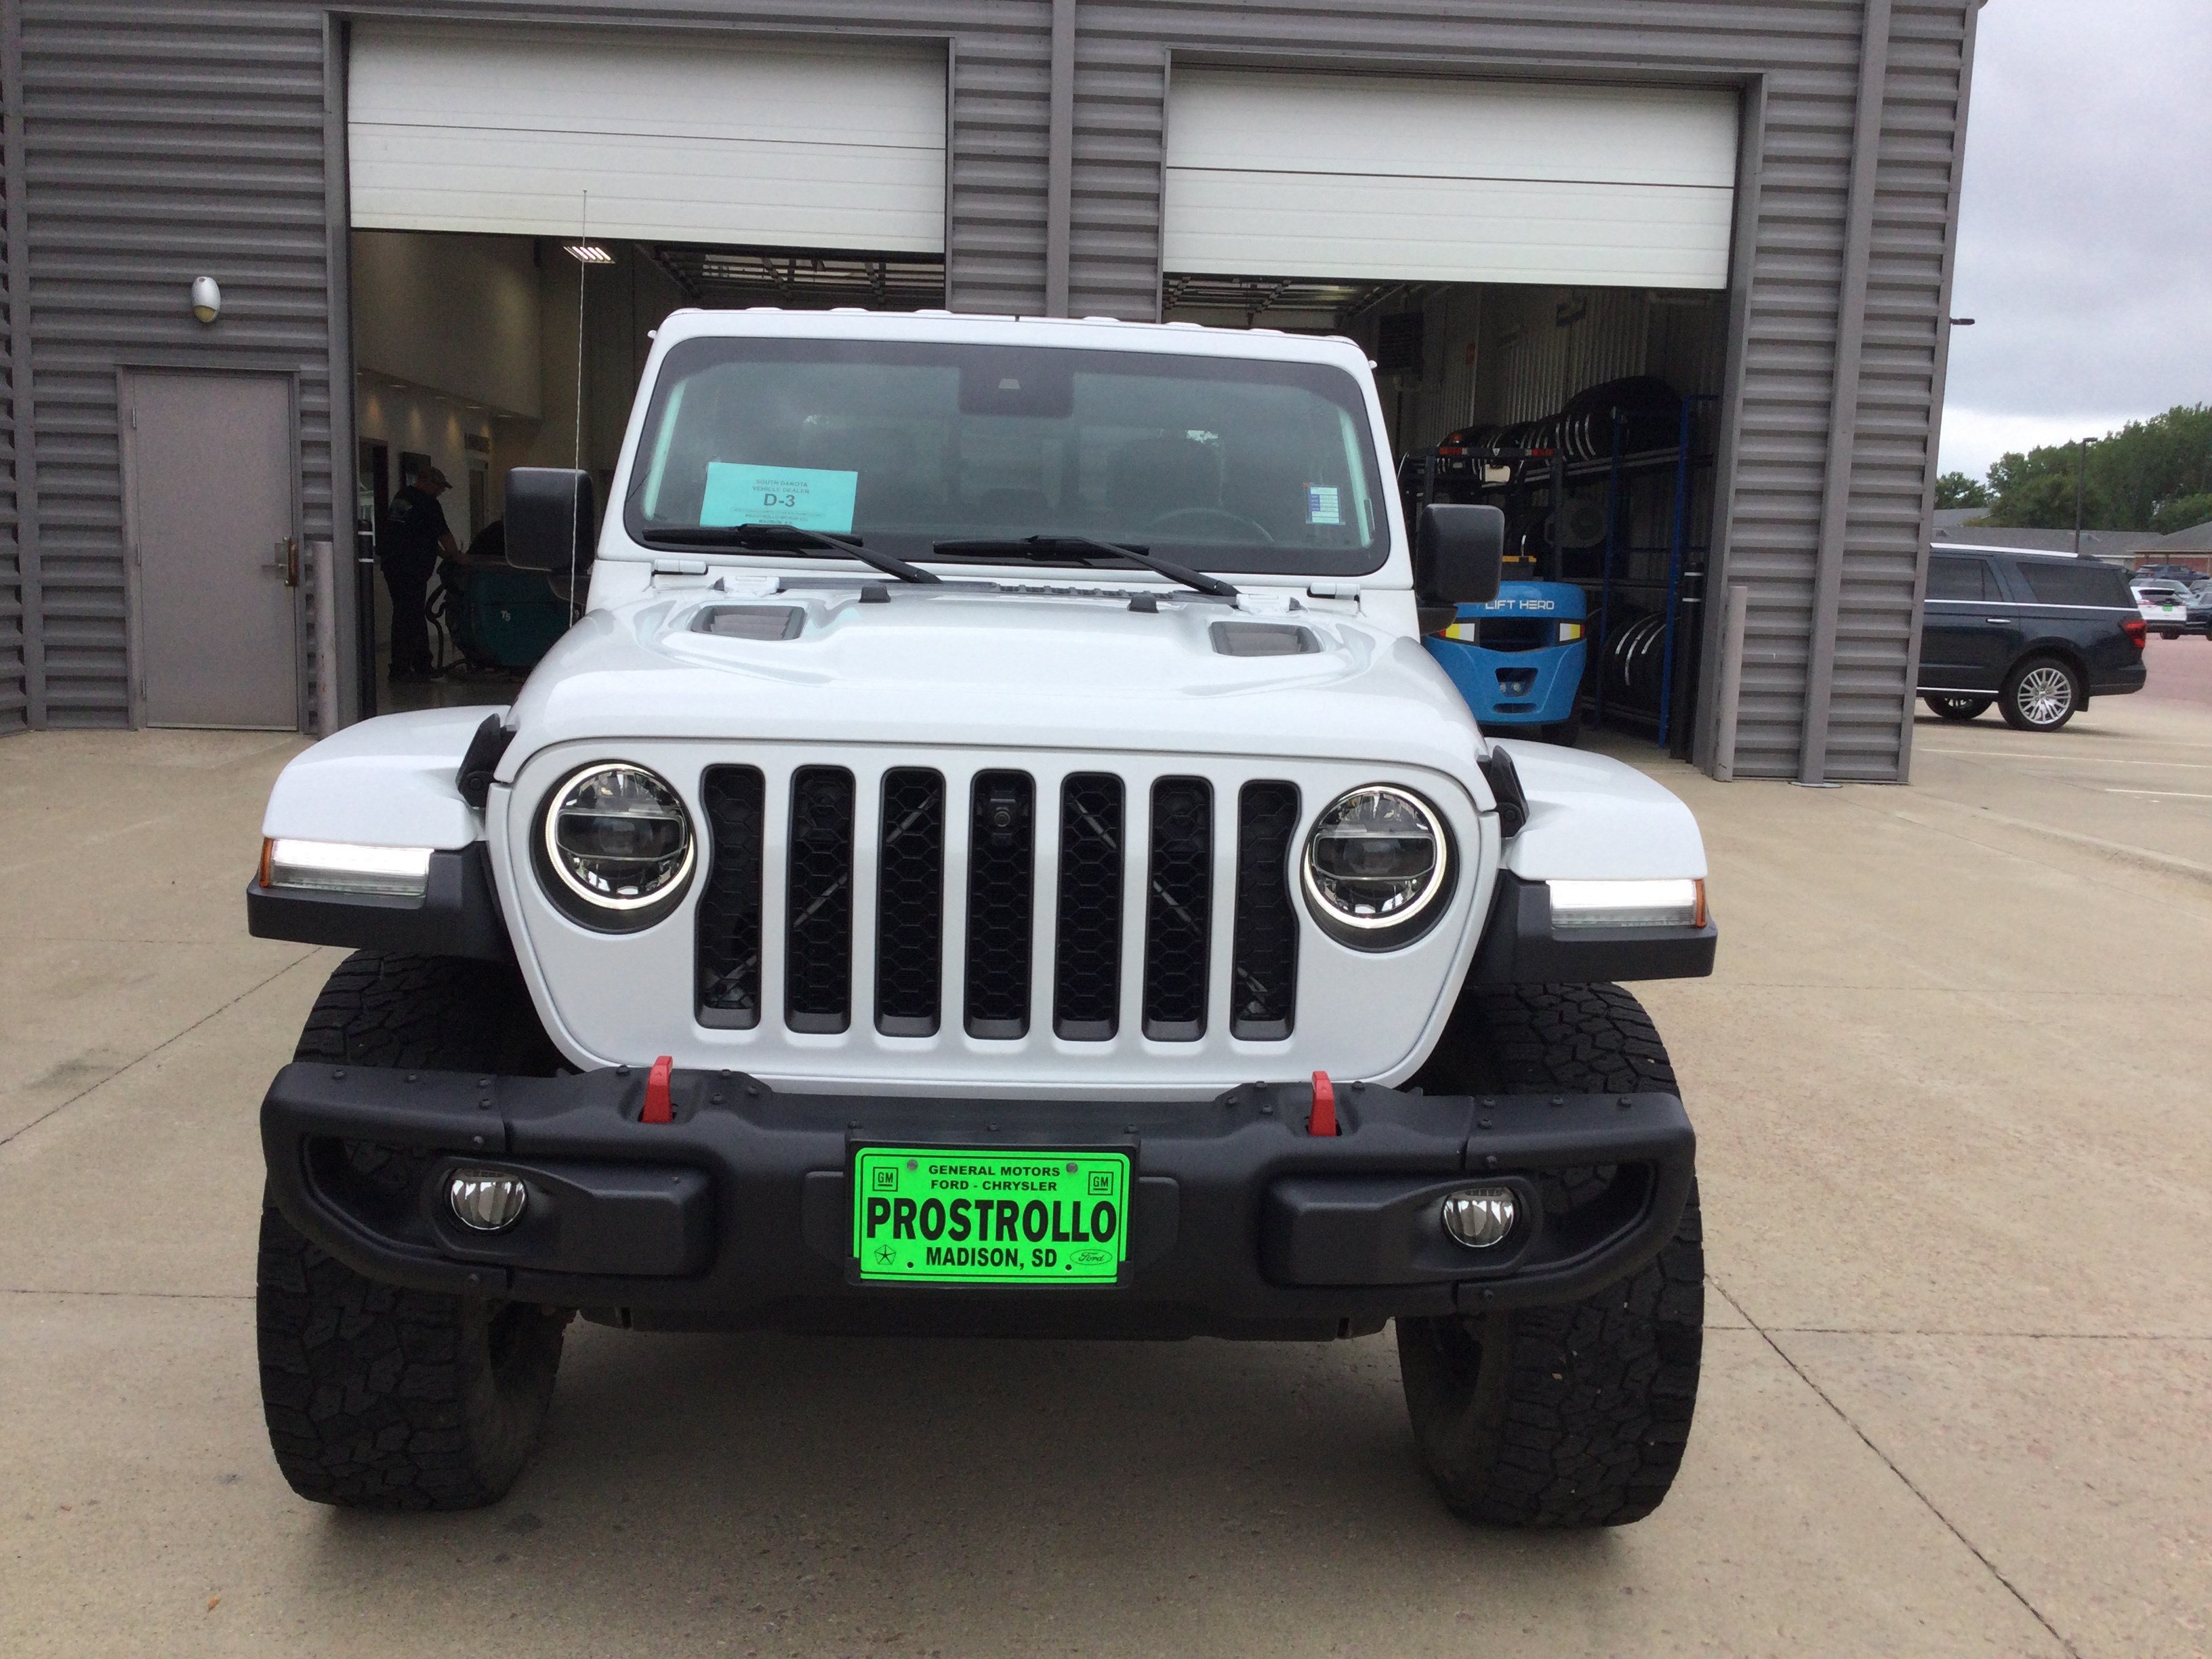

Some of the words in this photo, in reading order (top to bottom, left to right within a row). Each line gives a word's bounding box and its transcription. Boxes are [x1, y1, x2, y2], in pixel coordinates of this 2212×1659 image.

[763, 493, 796, 508] D-3
[1485, 600, 1516, 610] LIFT
[1519, 600, 1555, 610] HERO
[928, 1165, 996, 1176] GENERAL
[1000, 1166, 1061, 1177] MOTORS
[878, 1172, 893, 1183] GM
[1093, 1176, 1109, 1187] GM
[930, 1180, 969, 1190] FORD
[982, 1181, 1057, 1191] CHRYSLER
[866, 1197, 1118, 1243] PROSTROLLO
[926, 1246, 1025, 1270] MADISON,
[1031, 1248, 1057, 1267] SD
[1078, 1250, 1105, 1262] Ford
